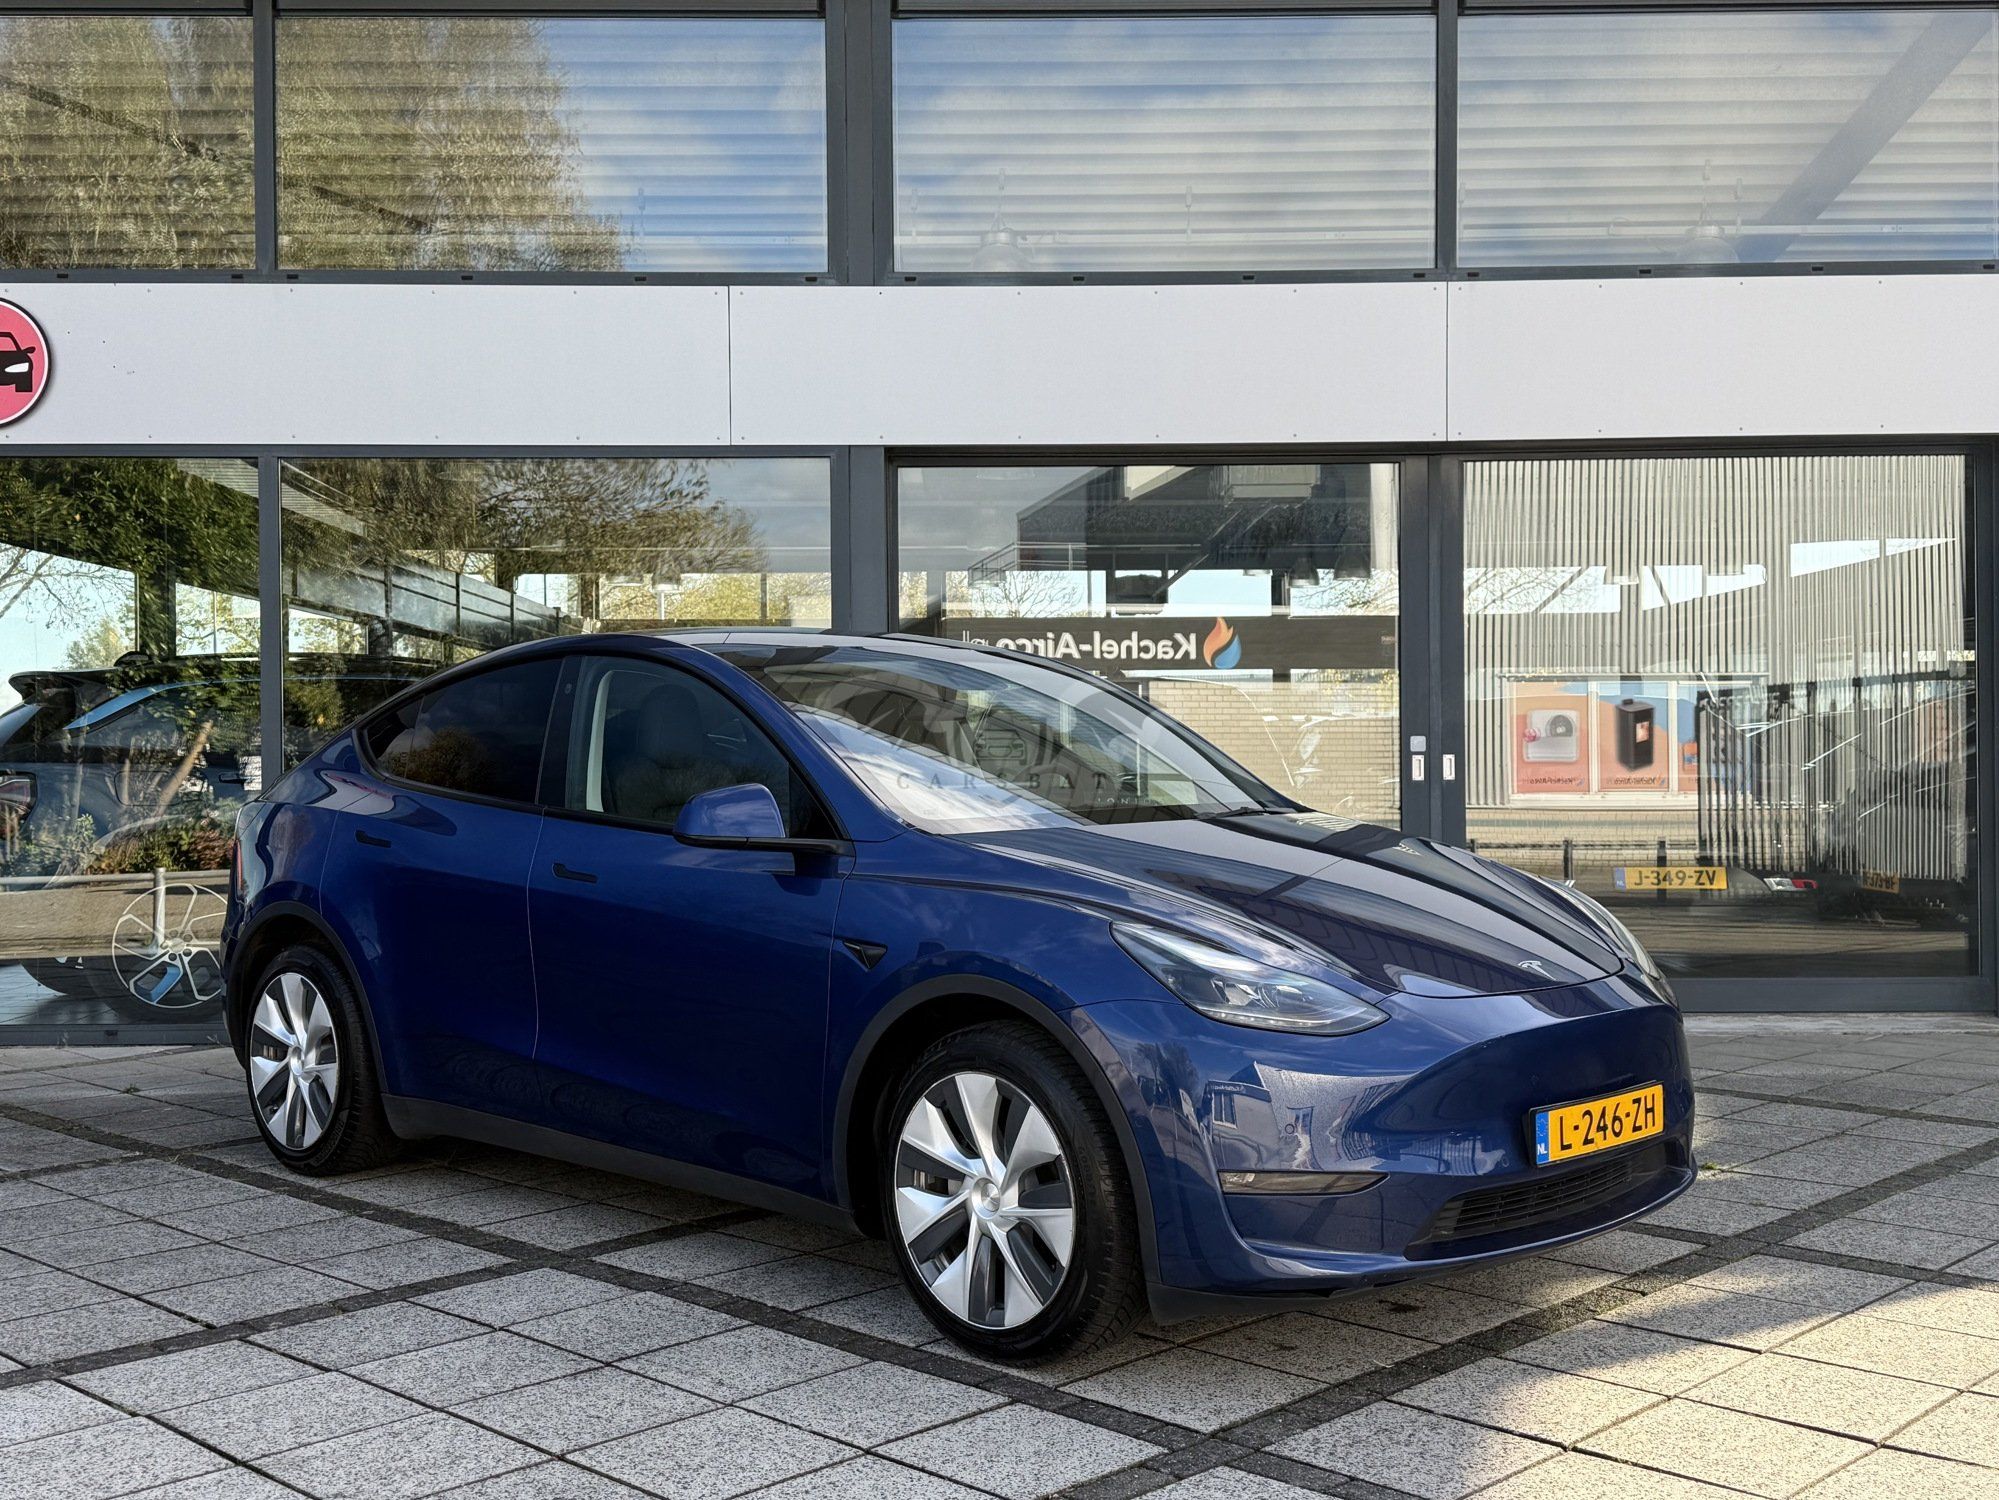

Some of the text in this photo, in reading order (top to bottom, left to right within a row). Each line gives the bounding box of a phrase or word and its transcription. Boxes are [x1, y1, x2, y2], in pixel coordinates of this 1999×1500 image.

[1634, 870, 1716, 886] J-349-ZV
[1537, 1093, 1656, 1155] NL L-246-ZH
